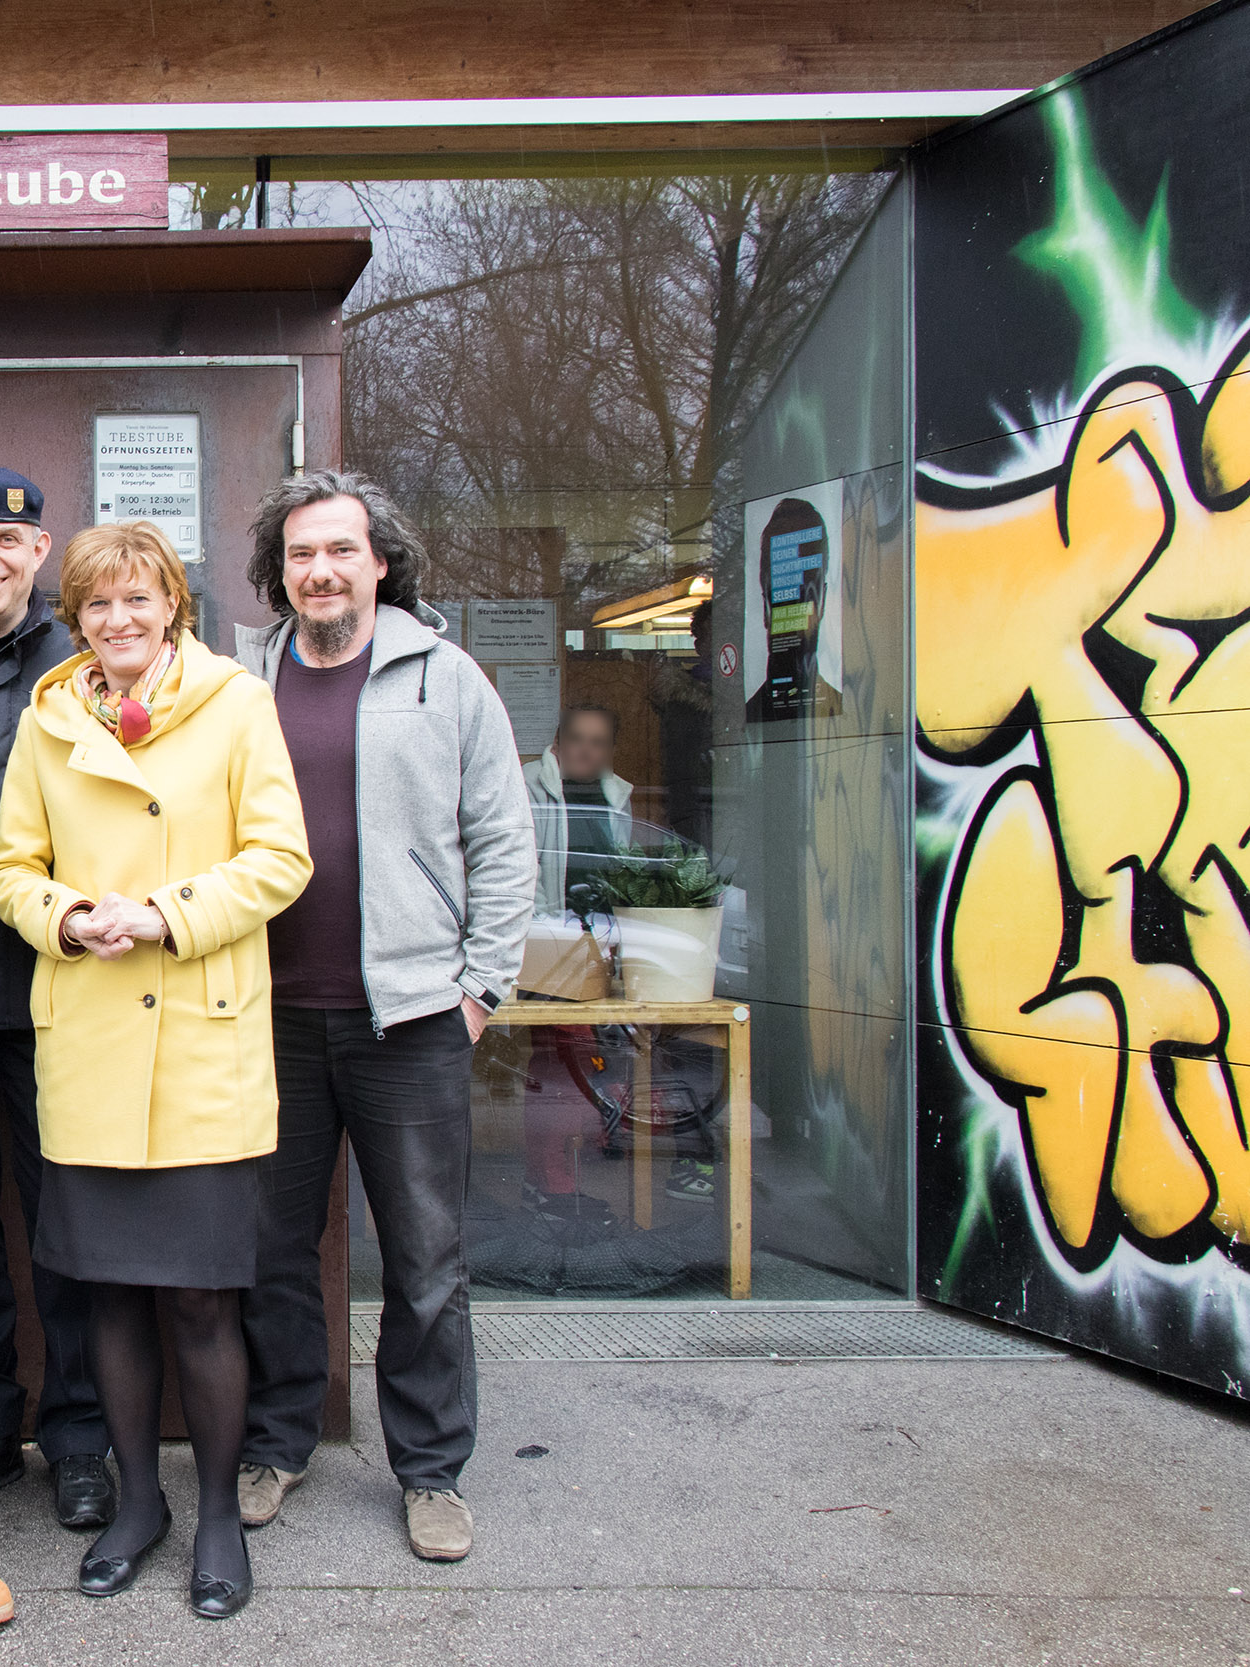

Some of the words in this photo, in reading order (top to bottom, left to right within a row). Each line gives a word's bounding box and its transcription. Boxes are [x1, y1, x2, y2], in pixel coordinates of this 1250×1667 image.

[109, 432, 185, 442] TEESTUBE
[100, 445, 193, 454] ÖFFNUNGSZEITEN
[120, 496, 139, 504] 9:00
[150, 496, 174, 504] 12:30
[128, 508, 182, 516] Café-Betrieb
[772, 528, 821, 547] KONTROLLIERE
[772, 547, 798, 560] DEINEN
[773, 588, 799, 602] SELBST.
[477, 608, 545, 616] Streetwork-Büro
[773, 607, 787, 619] WIR
